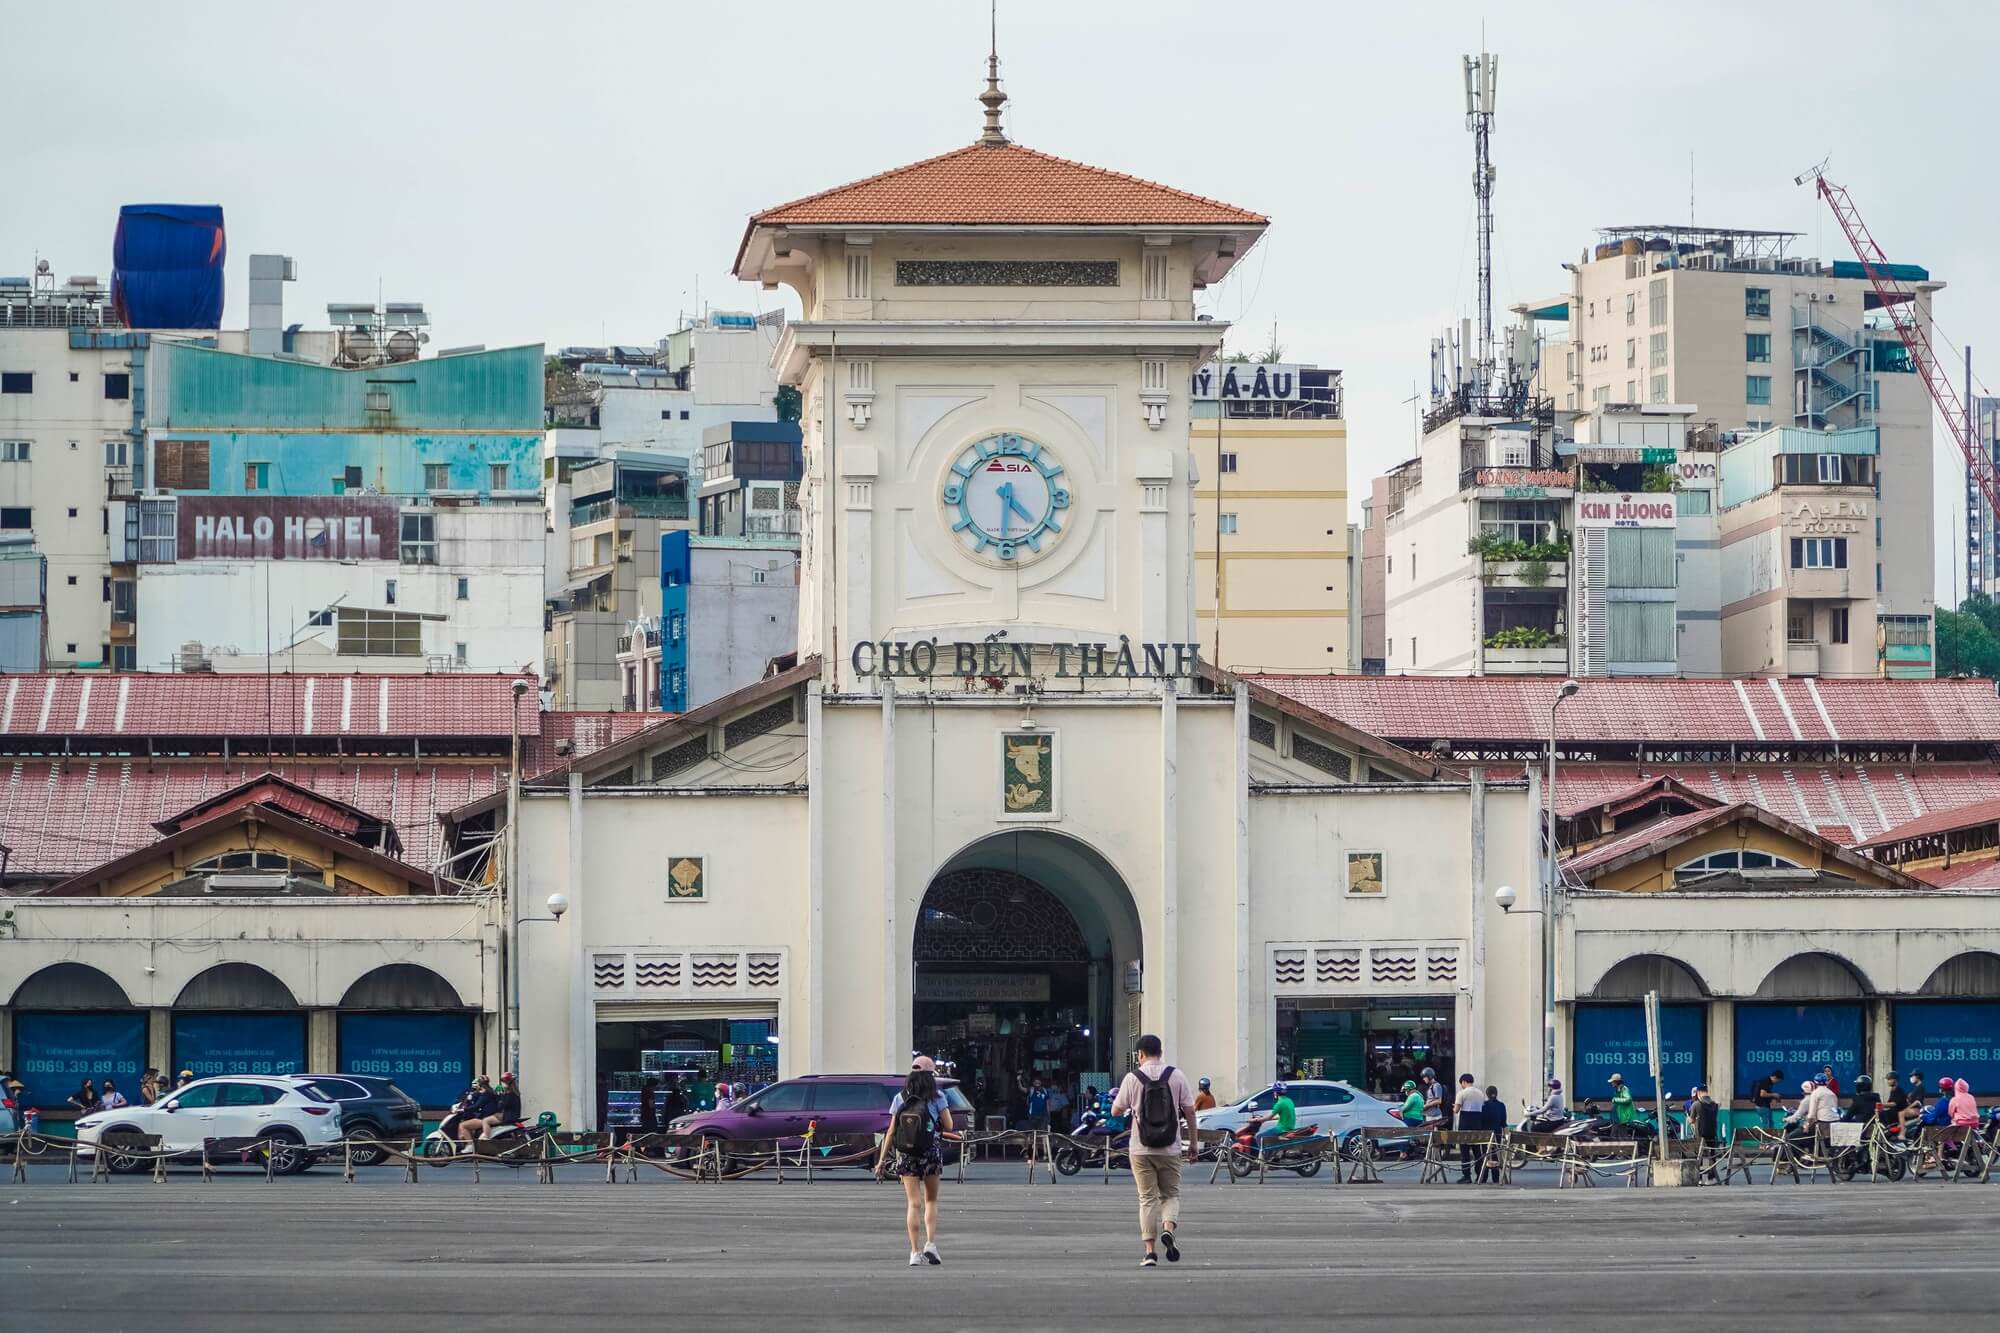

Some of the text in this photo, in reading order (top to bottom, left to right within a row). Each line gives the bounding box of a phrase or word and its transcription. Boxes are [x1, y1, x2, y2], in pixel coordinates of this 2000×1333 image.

[1222, 366, 1292, 398] Á-ÂU
[944, 486, 961, 505] 9
[1052, 488, 1069, 508] 3
[1581, 503, 1673, 519] KIM HUONG
[195, 516, 274, 540] HALO
[1801, 522, 1859, 534] HOTEL
[996, 541, 1014, 559] 6
[852, 629, 1201, 682] CHỢ BẾN THÀNH
[1585, 1052, 1693, 1065] 0969.39.9.89
[1747, 1050, 1854, 1063] 0969.39.89.89
[27, 1060, 137, 1073] 0969.39.89.89
[352, 1060, 462, 1073] 0969.39.89.89
